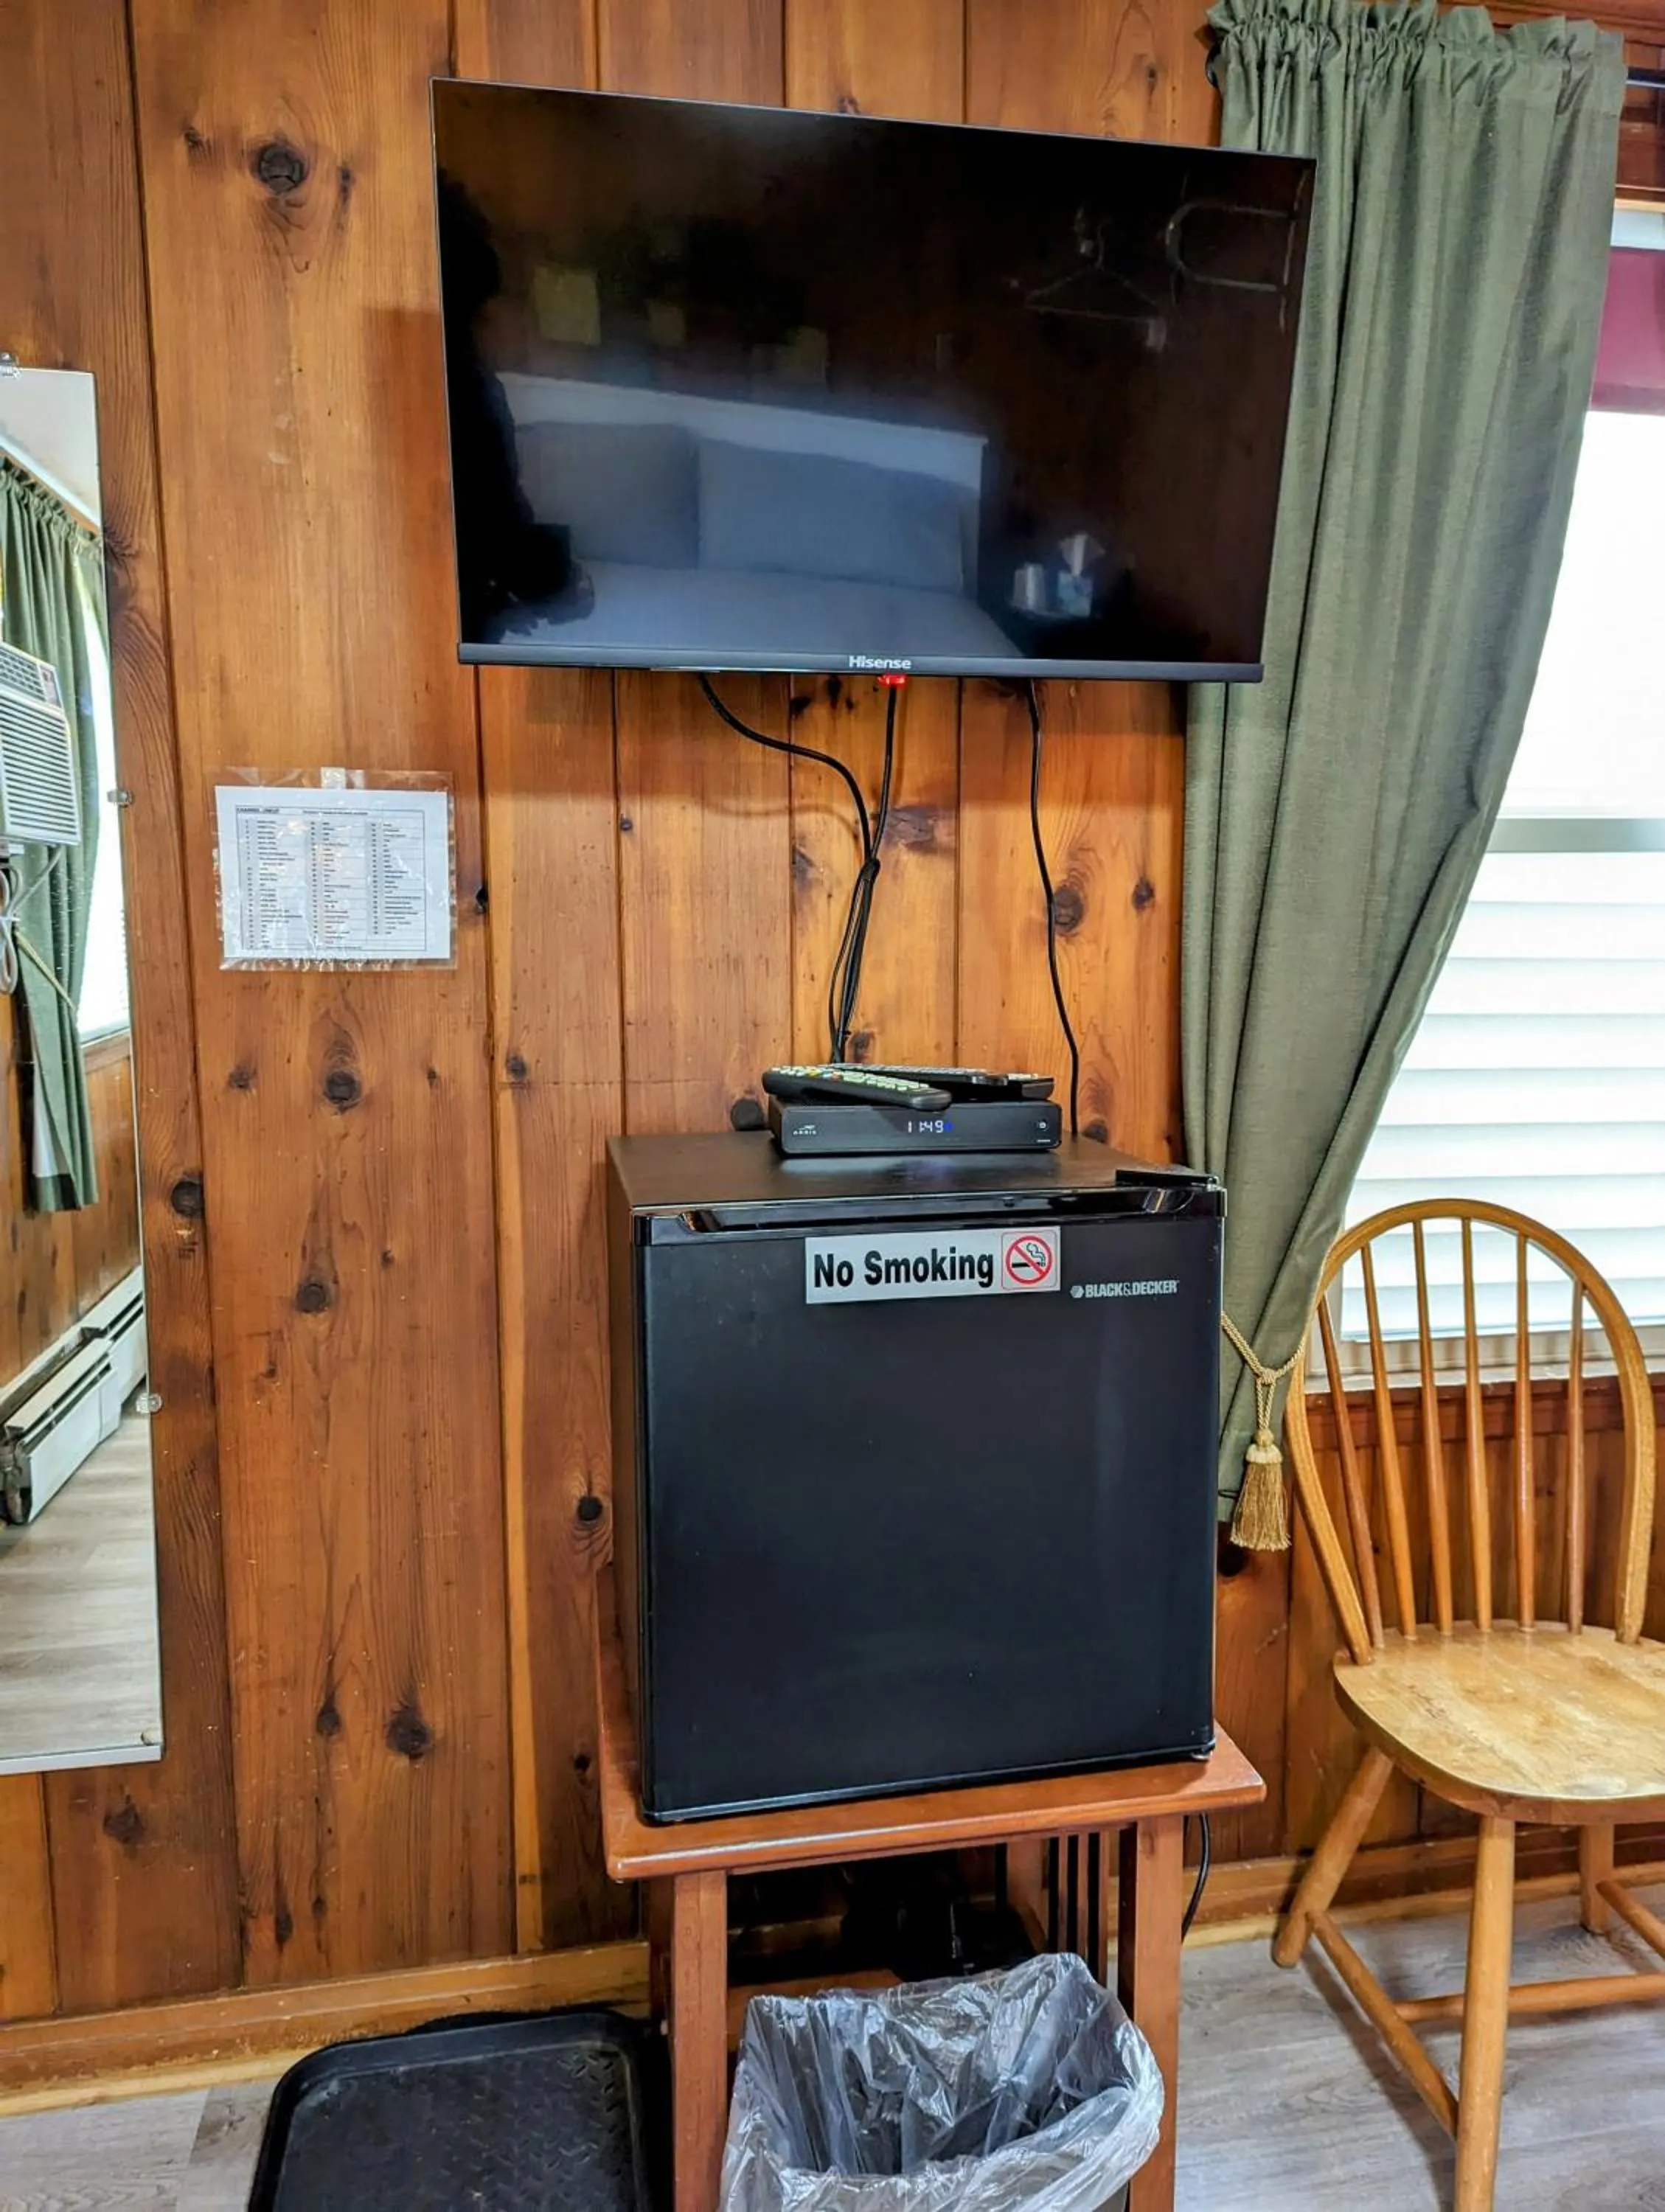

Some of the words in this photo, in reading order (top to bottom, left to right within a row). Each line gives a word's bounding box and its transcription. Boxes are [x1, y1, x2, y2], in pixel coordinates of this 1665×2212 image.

[849, 655, 911, 669] Hisense
[908, 1120, 944, 1133] 11:49
[813, 1253, 854, 1288] No
[864, 1246, 994, 1288] Smoking
[1085, 1279, 1178, 1298] BLACK&DECKER
